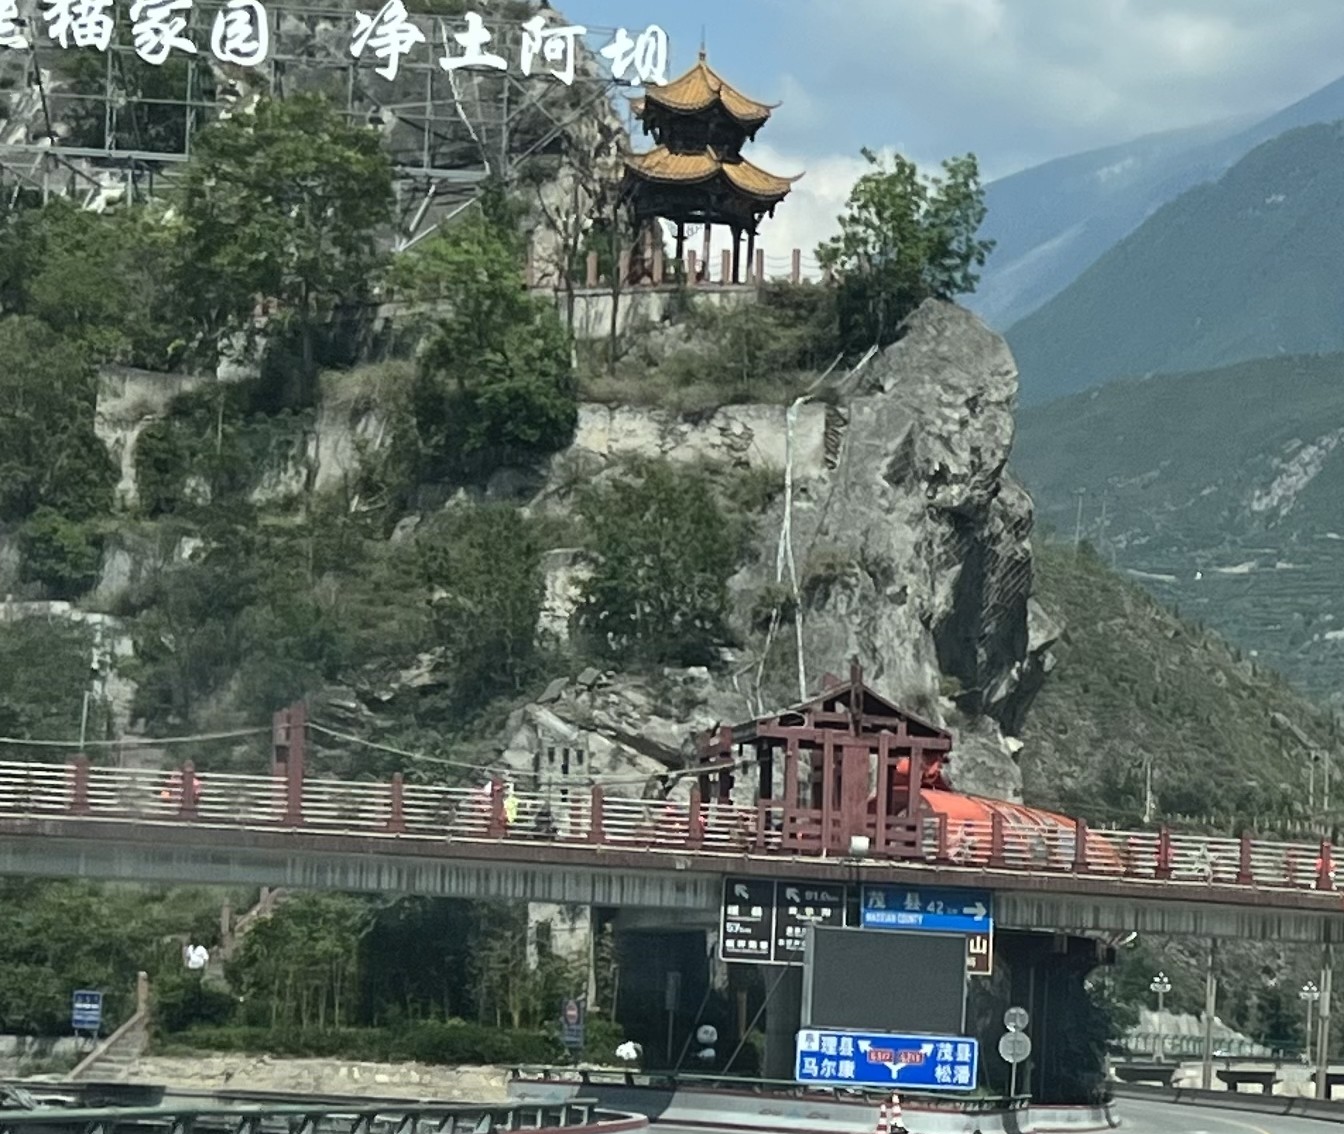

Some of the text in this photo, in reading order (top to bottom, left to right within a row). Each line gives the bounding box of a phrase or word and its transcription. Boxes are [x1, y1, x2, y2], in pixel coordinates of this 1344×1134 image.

[350, 0, 670, 87] 净土阿坝
[820, 1036, 854, 1058] 理县
[936, 1042, 972, 1063] 茂县
[802, 1057, 855, 1079] 马尔康
[935, 1064, 971, 1085] 松潘
